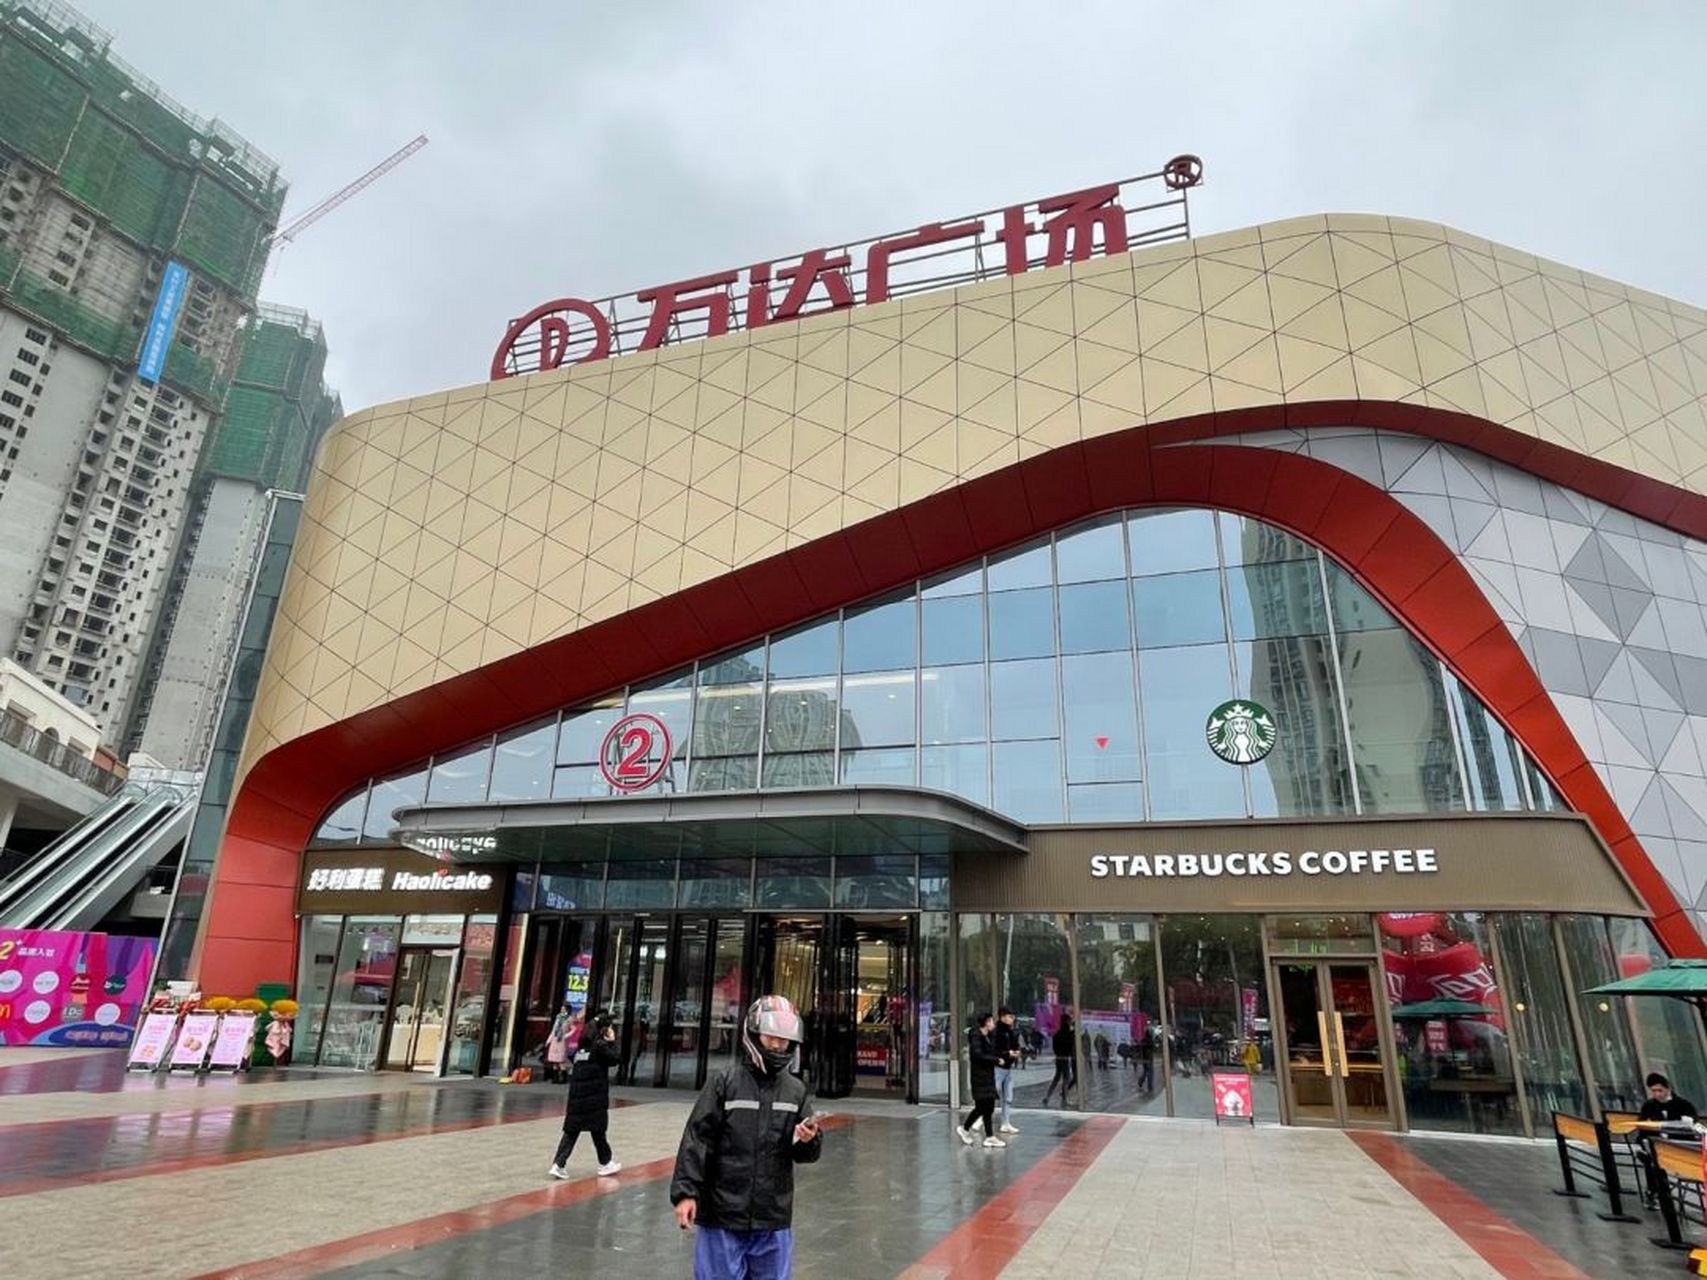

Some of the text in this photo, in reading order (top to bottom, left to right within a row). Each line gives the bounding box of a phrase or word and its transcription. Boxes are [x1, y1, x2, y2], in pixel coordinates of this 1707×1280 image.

[637, 183, 1129, 353] 万达广场
[615, 726, 653, 777] 2
[1090, 848, 1439, 877] STARBUCKS COFFEE
[307, 867, 385, 892] 好利蛋糕
[391, 868, 494, 892] Haolicake
